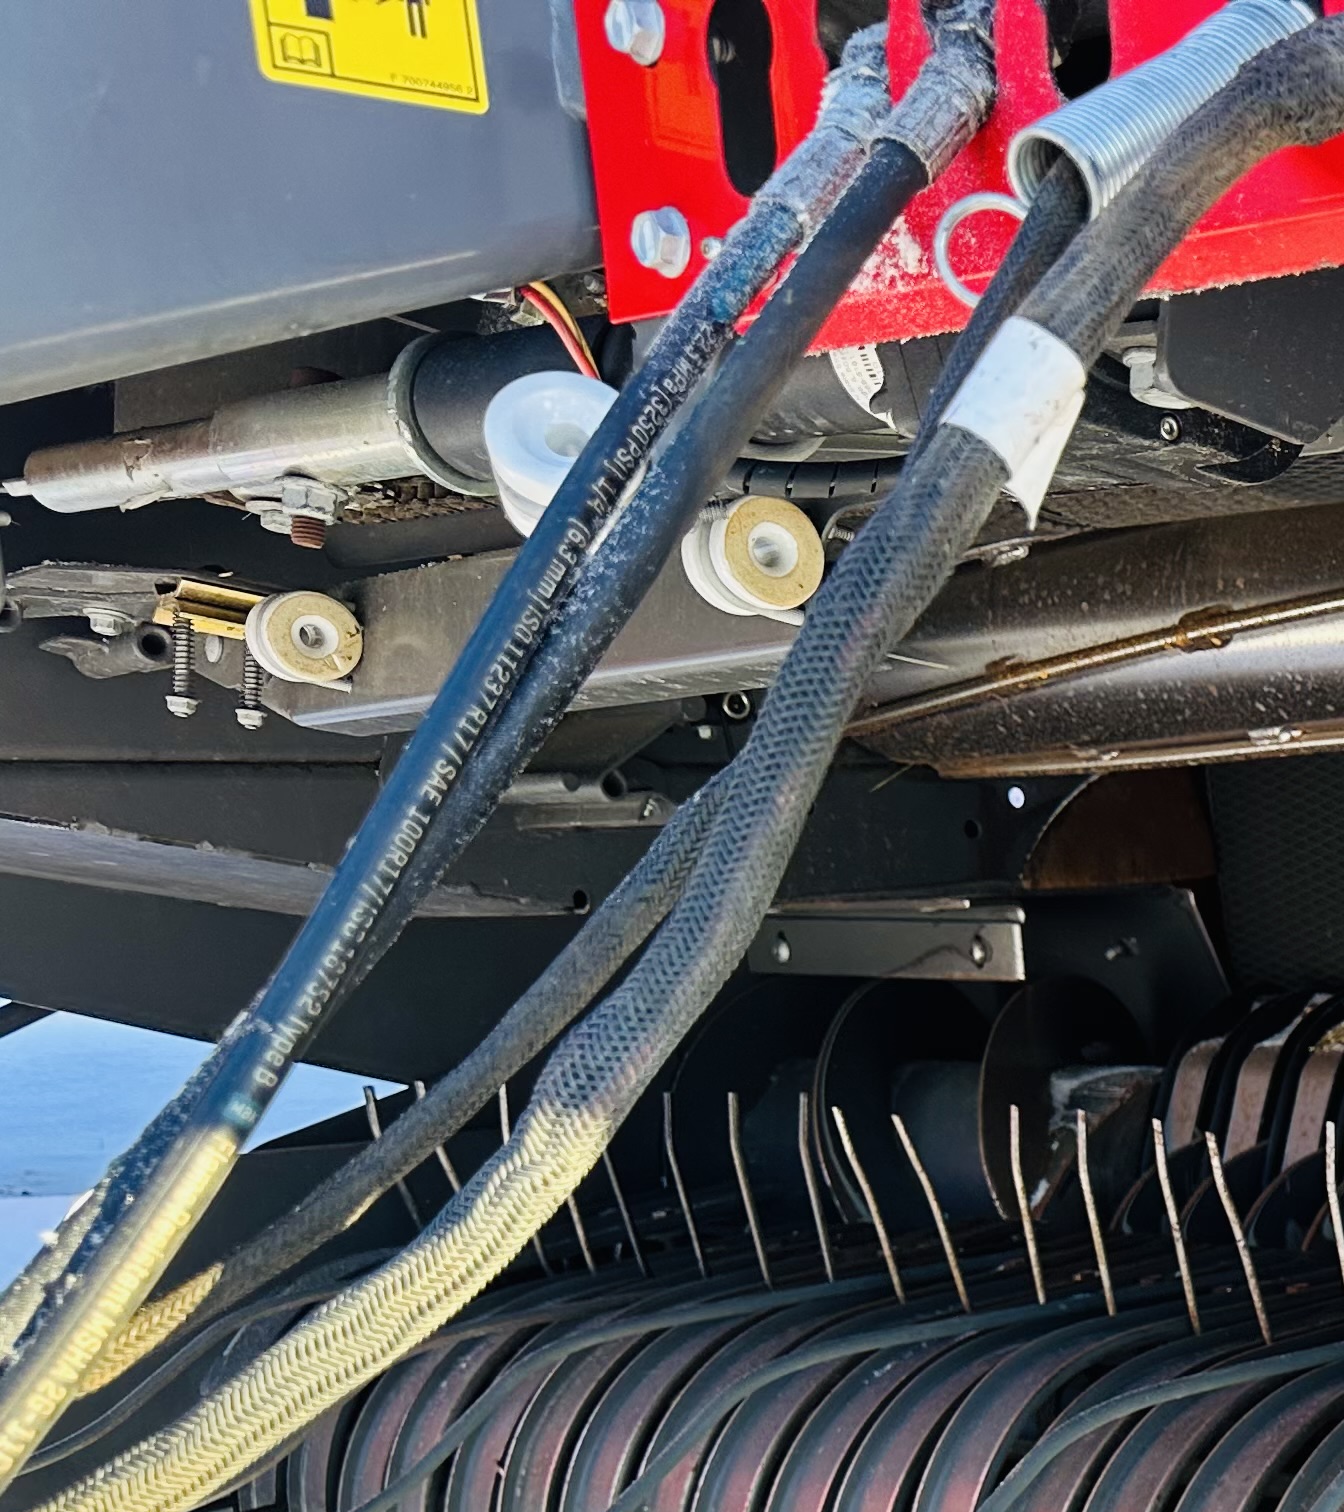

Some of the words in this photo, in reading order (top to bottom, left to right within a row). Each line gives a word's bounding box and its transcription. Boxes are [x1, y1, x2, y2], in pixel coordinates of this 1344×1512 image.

[662, 355, 693, 393] MPa
[585, 475, 618, 513] 1/4
[513, 604, 544, 643] ISO
[479, 639, 525, 709] 11237
[262, 1012, 311, 1069] Type
[253, 1066, 278, 1088] B
[170, 1133, 237, 1212] Flame
[102, 1206, 192, 1319] Resistant
[49, 1308, 116, 1388] MSHA
